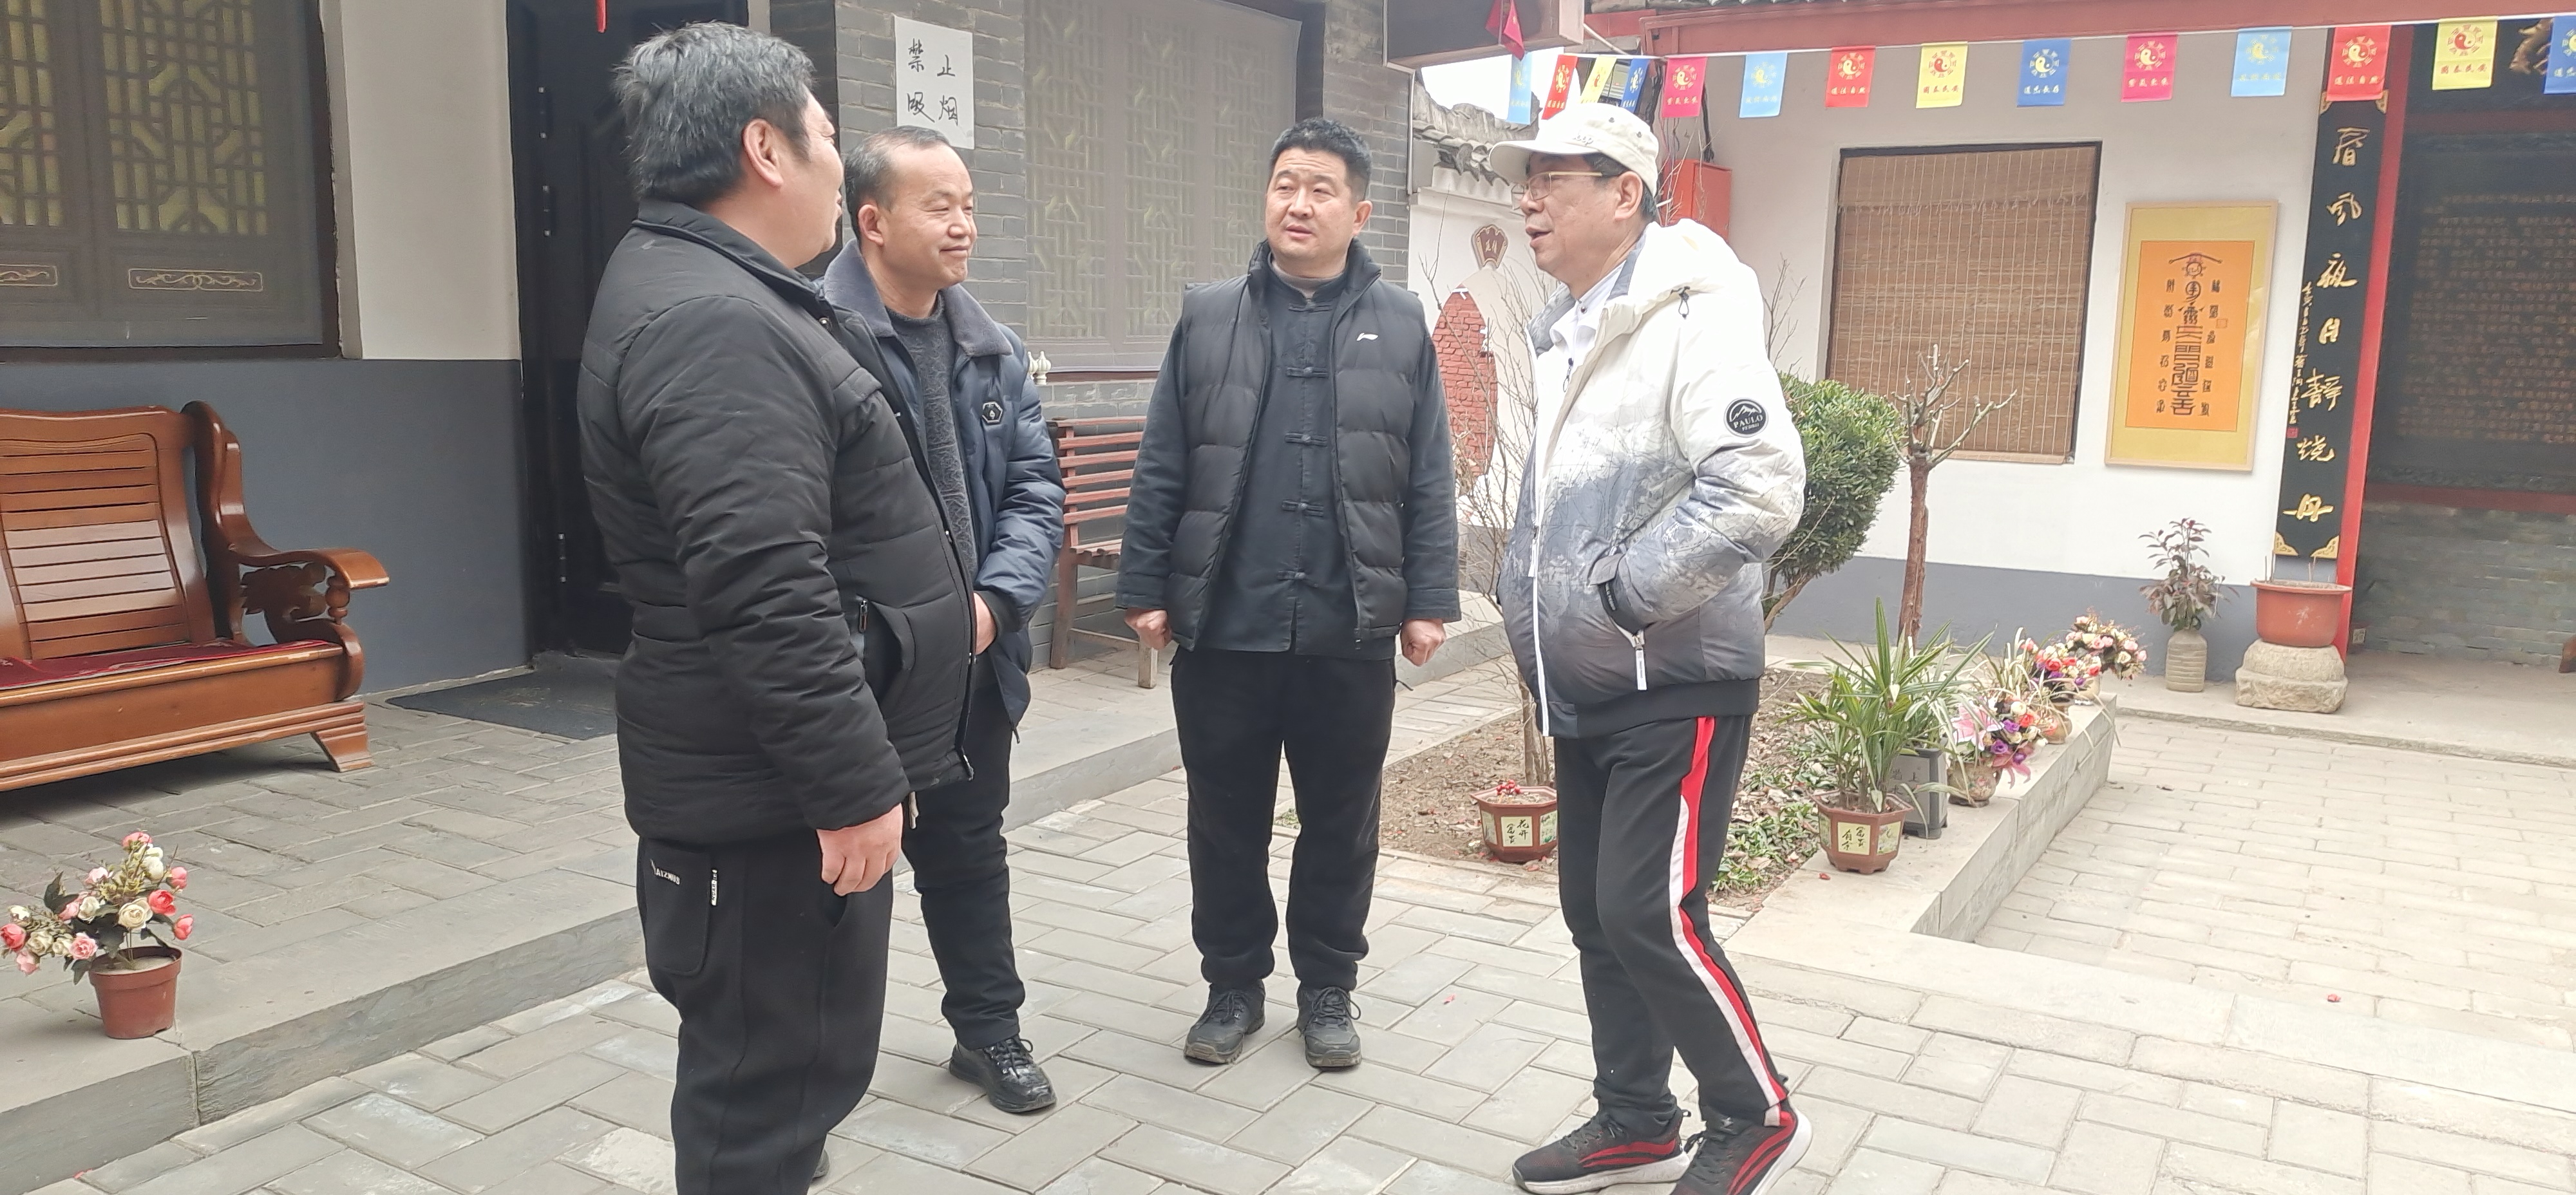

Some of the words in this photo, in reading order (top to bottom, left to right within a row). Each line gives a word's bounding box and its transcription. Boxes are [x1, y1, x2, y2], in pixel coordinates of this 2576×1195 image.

[907, 37, 956, 77] 禁止
[907, 91, 958, 126] 吸烟
[1733, 415, 1763, 429] PAULO
